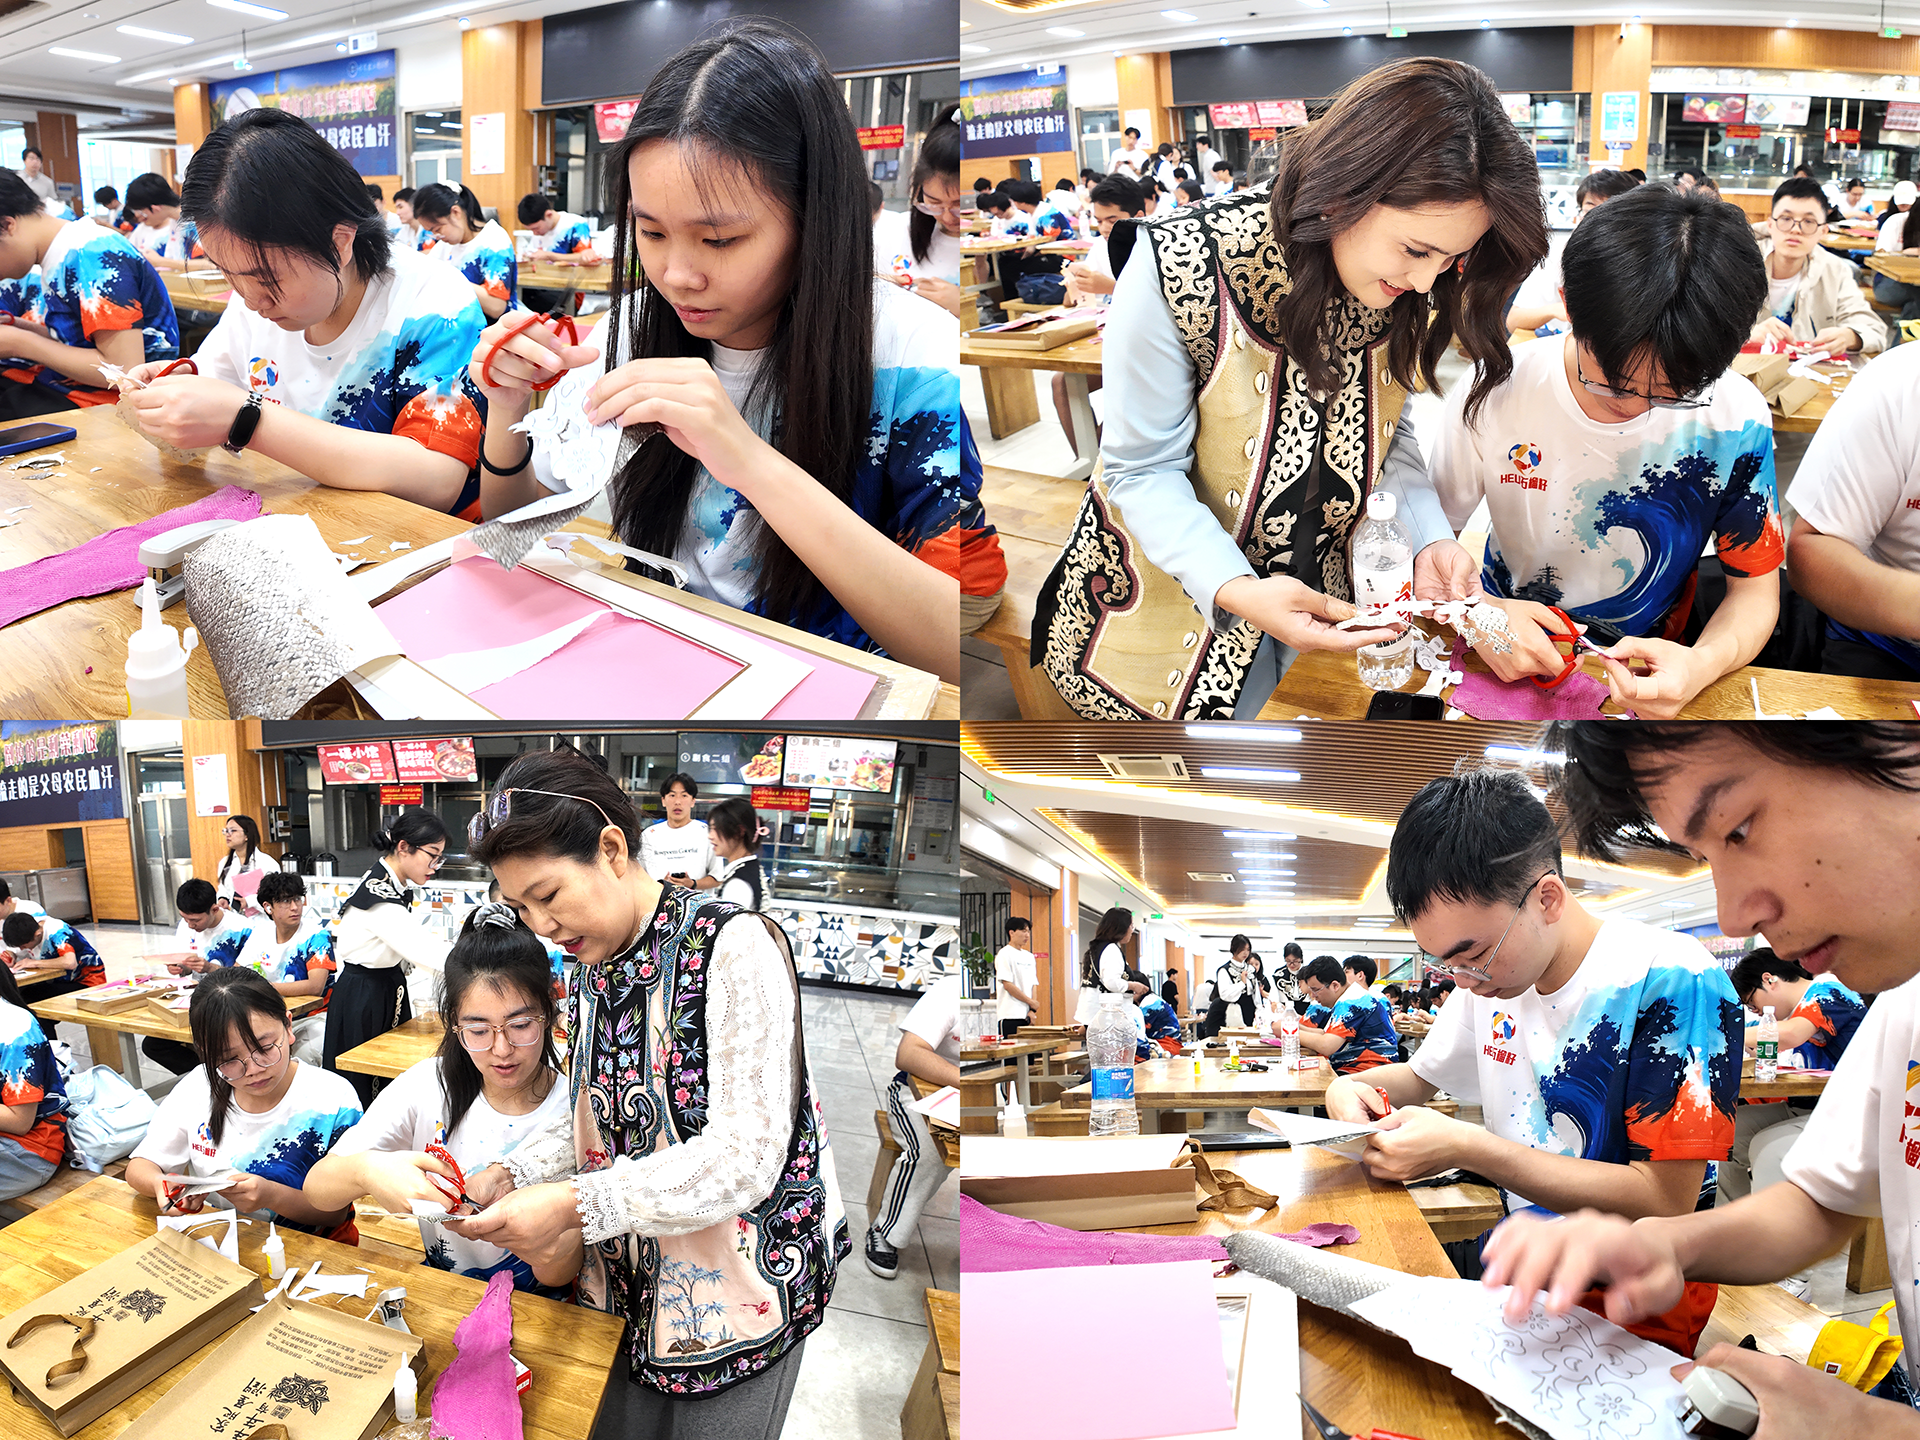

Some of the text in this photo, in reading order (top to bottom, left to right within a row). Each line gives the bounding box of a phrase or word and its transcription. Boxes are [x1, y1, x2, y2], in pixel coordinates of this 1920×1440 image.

[4, 727, 98, 767] 倒掉的是剩菜剩饭
